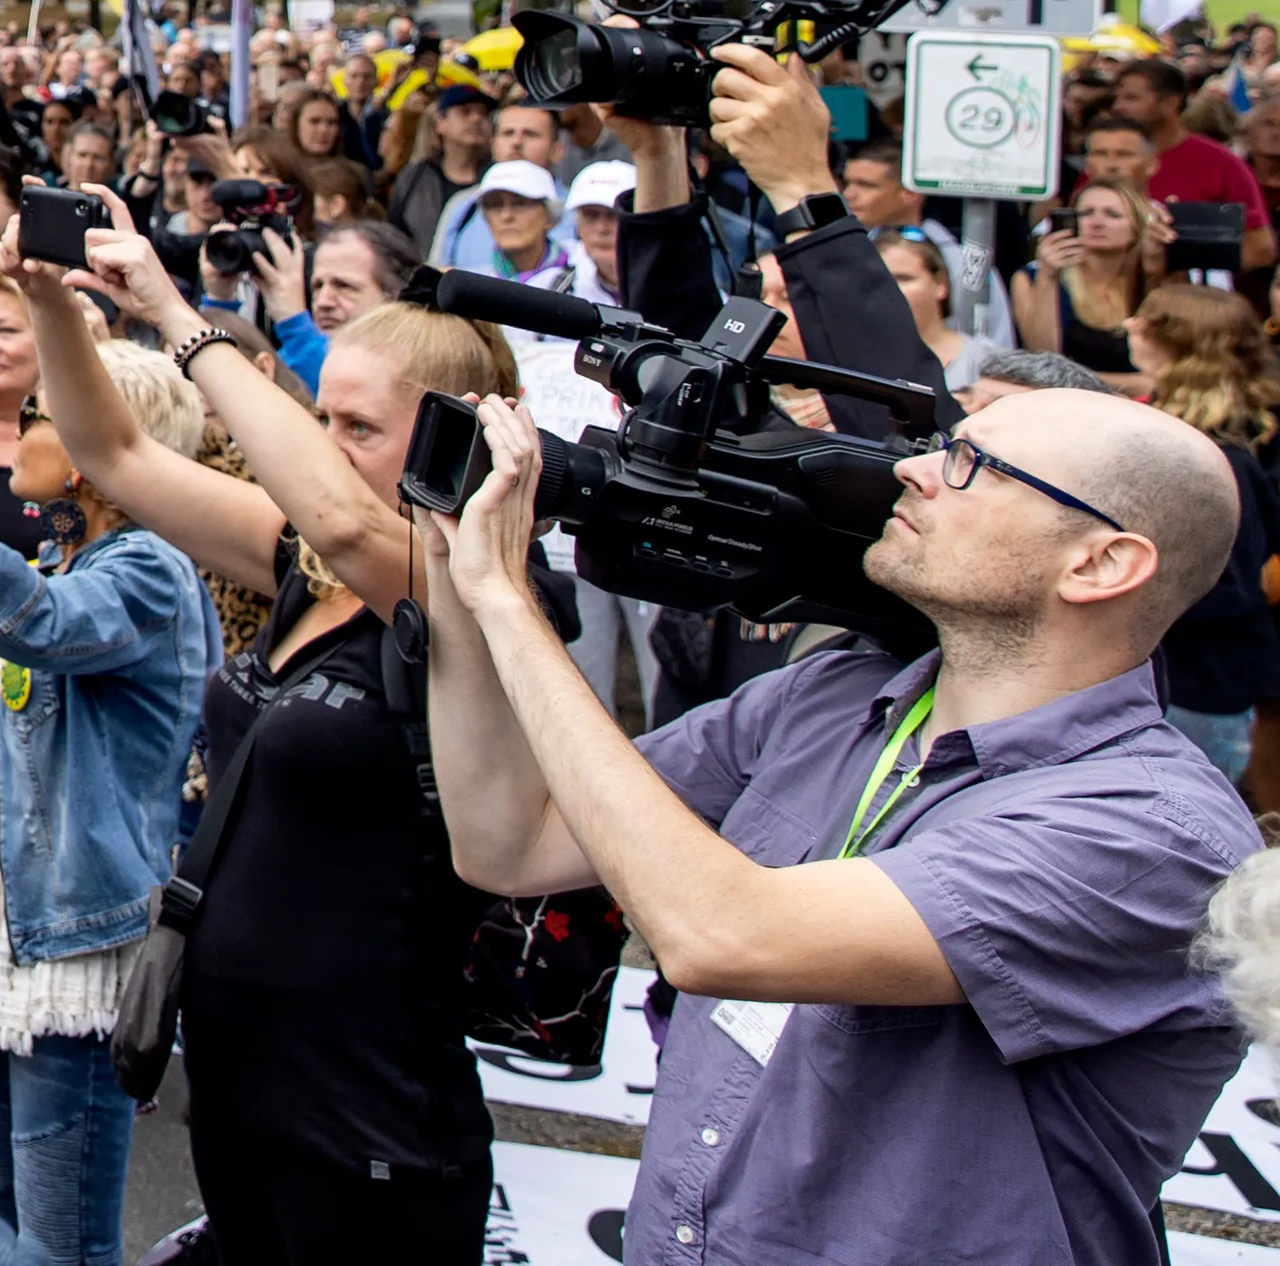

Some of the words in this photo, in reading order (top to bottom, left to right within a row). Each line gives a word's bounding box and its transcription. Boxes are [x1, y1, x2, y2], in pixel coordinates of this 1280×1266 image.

[959, 104, 1003, 131] 29
[724, 319, 745, 333] HD
[582, 354, 602, 367] SONY
[581, 487, 592, 496] G
